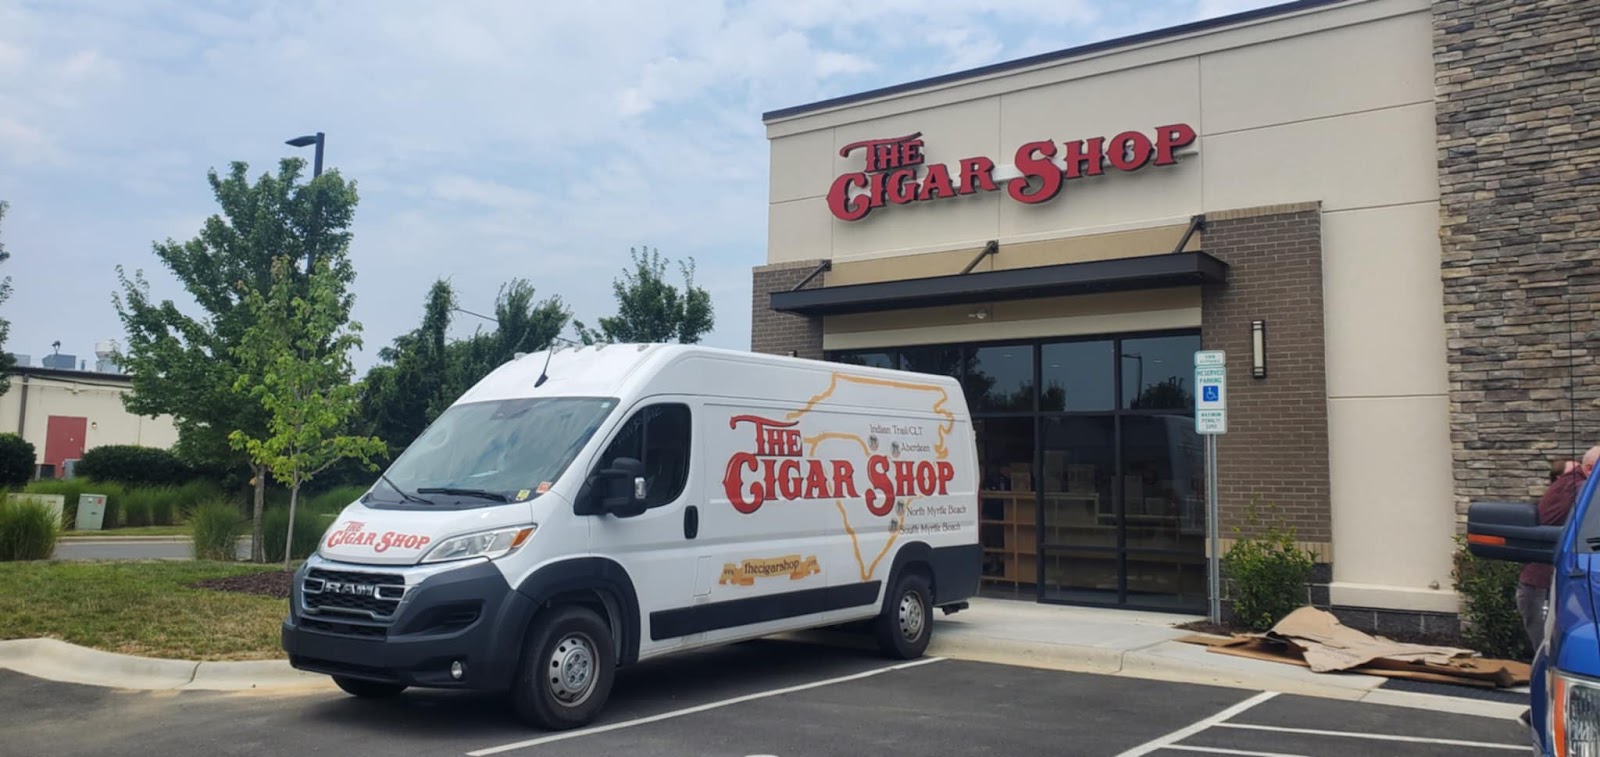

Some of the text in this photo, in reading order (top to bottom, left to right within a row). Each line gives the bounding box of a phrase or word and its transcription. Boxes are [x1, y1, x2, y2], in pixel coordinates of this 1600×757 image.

[839, 131, 924, 174] THE
[826, 123, 1198, 222] CIGAR SHOP
[729, 414, 804, 457] THE
[901, 442, 931, 453] Aberdeen
[722, 452, 955, 517] CIGAR SHOP
[906, 504, 967, 517] North Myrtle Beach
[343, 521, 365, 532] THE
[899, 521, 961, 535] South Myrtle Beach
[328, 531, 431, 553] CIGAR SHOP
[744, 559, 800, 575] thecigarshop
[325, 581, 374, 597] RAM
